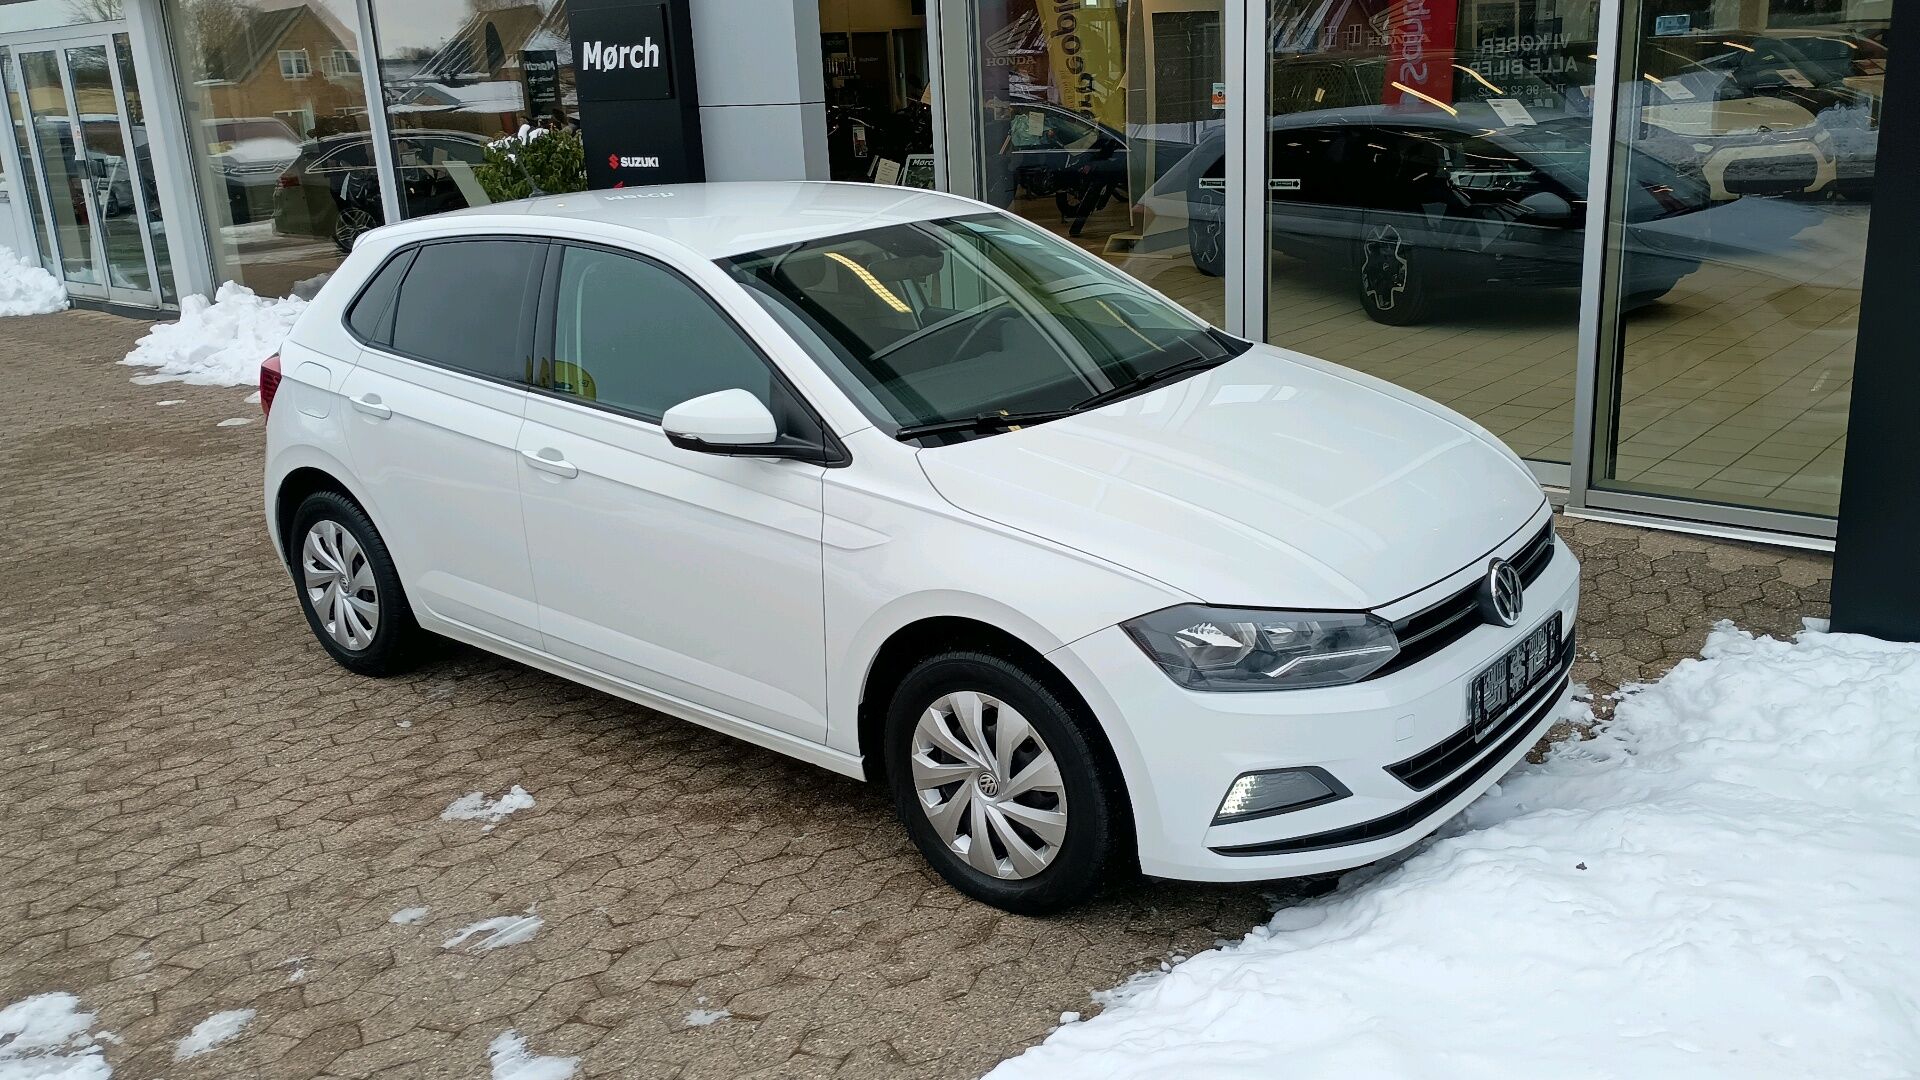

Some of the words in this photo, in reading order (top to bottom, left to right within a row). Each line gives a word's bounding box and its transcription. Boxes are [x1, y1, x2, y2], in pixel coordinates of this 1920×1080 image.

[582, 37, 659, 73] Mørch
[986, 56, 1036, 67] HONDA
[620, 157, 659, 168] SUZUKI
